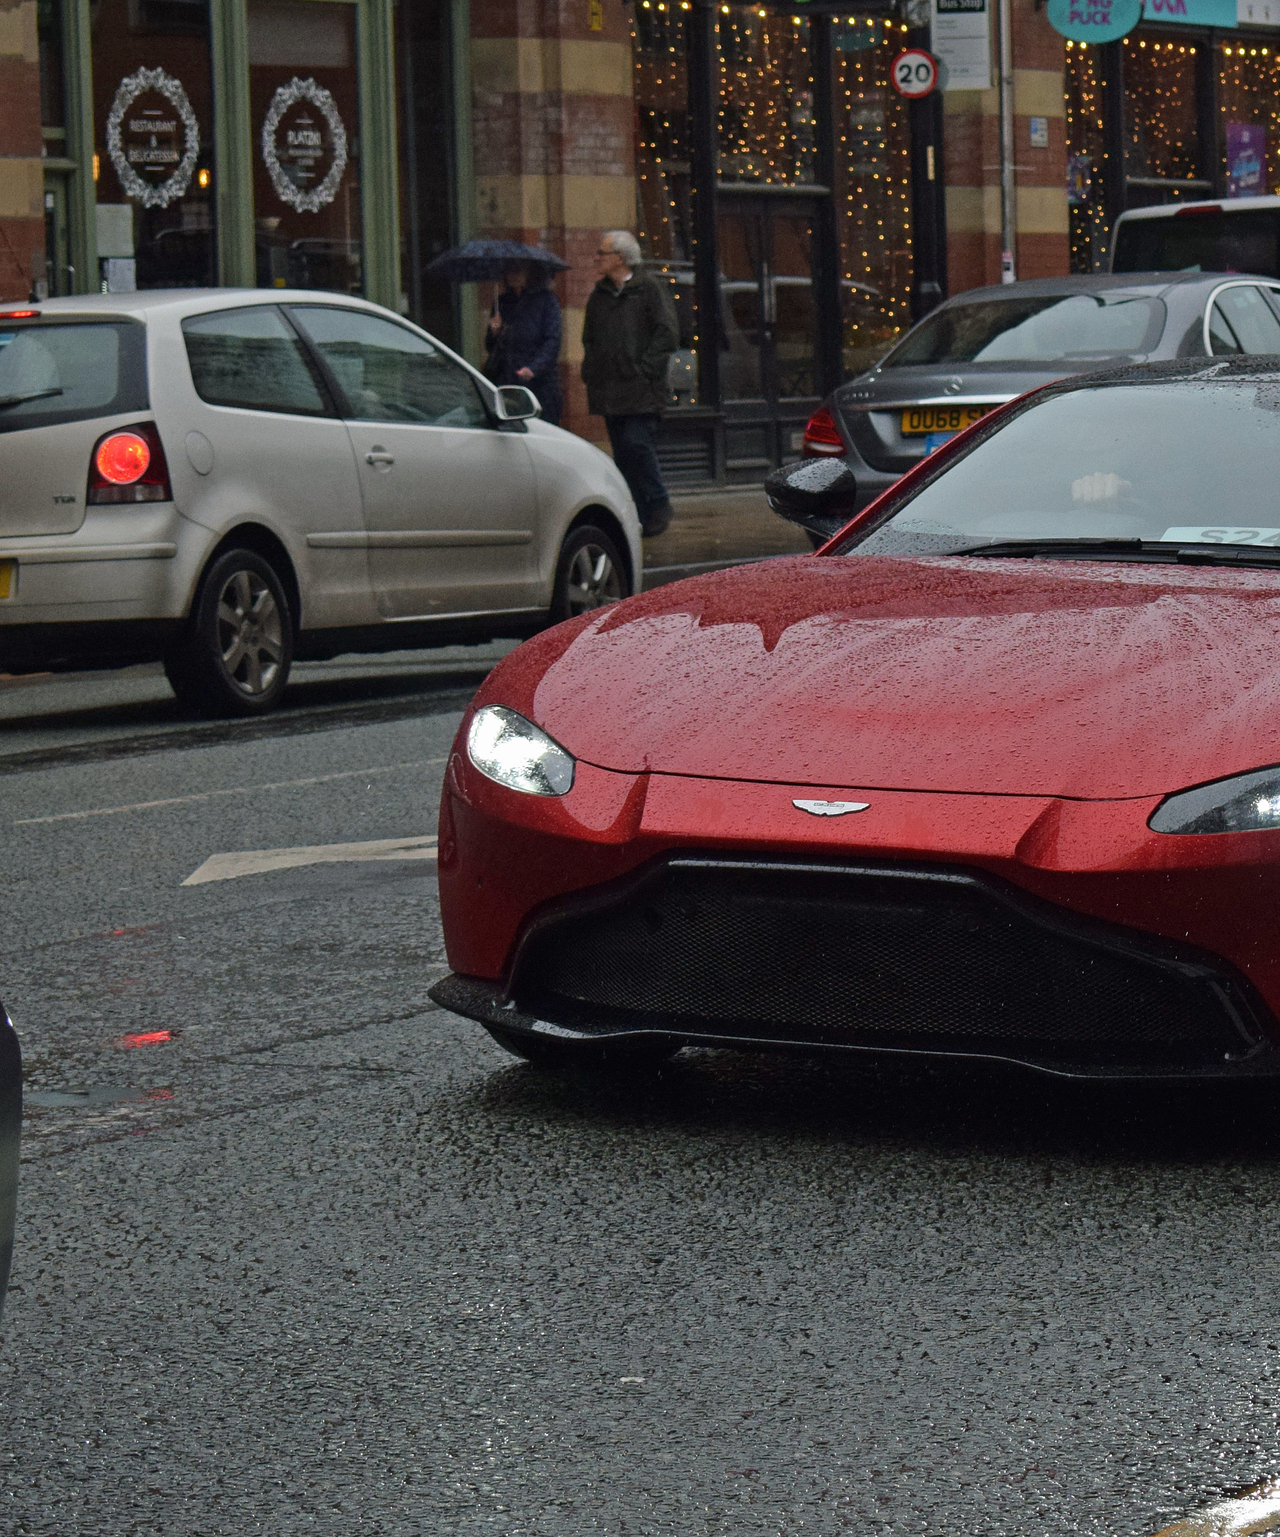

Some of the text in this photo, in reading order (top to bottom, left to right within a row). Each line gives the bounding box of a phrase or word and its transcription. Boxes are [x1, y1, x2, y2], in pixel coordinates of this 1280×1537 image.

[1069, 11, 1112, 25] PUCK
[899, 63, 931, 83] 20
[129, 120, 177, 132] RESTAURANT
